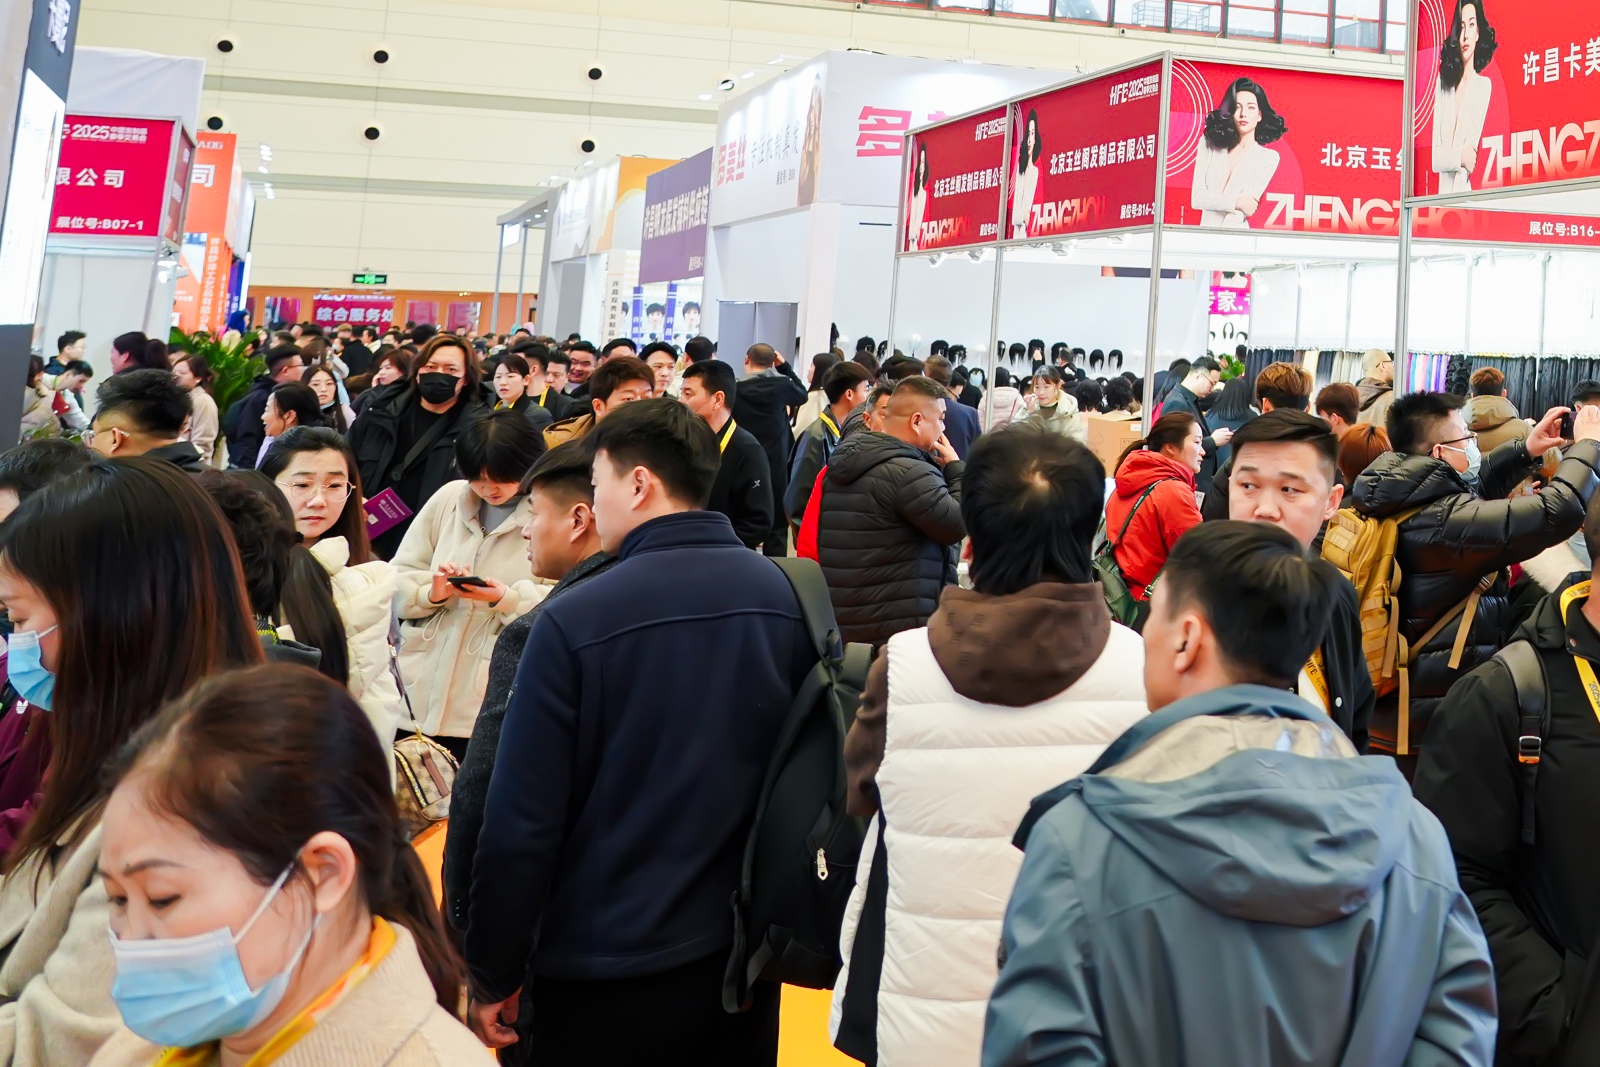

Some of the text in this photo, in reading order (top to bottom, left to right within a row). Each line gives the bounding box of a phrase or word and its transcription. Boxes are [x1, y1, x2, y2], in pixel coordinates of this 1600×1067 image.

[1110, 82, 1128, 106] HFE
[1128, 77, 1143, 98] 2025
[72, 124, 110, 138] 2025
[1050, 134, 1156, 175] 北京玉丝阁发制品有限公司
[56, 216, 144, 231] 展位号:B07-1
